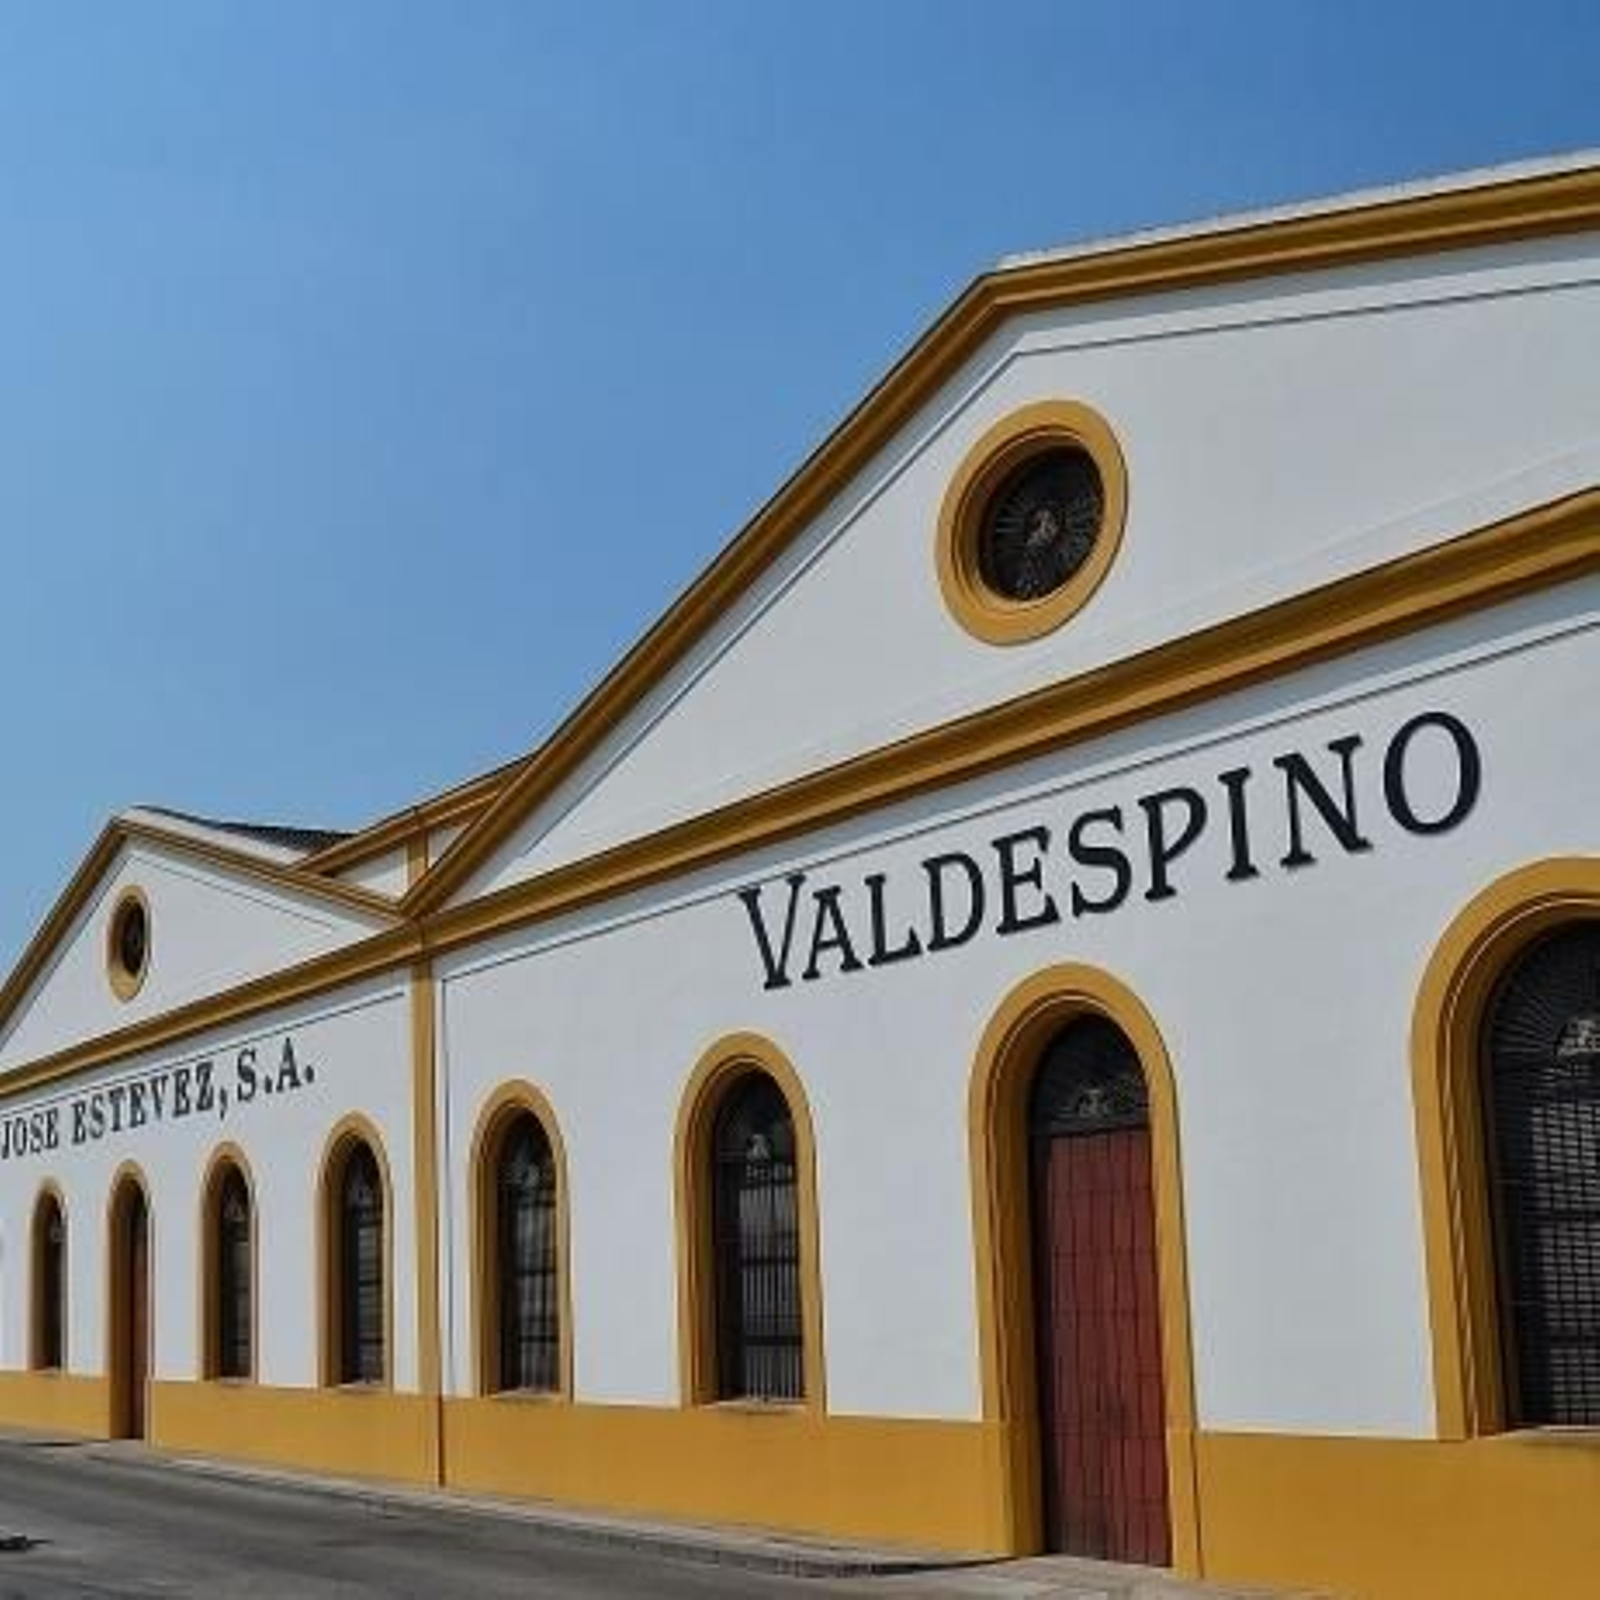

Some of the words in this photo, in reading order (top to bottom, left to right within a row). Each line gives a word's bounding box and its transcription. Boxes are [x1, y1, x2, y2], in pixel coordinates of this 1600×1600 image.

[738, 711, 1482, 991] VALDESPINO
[1, 1107, 59, 1159] JOSE
[71, 1062, 228, 1145] ESTEVEZ,
[237, 1037, 315, 1102] S.A.
